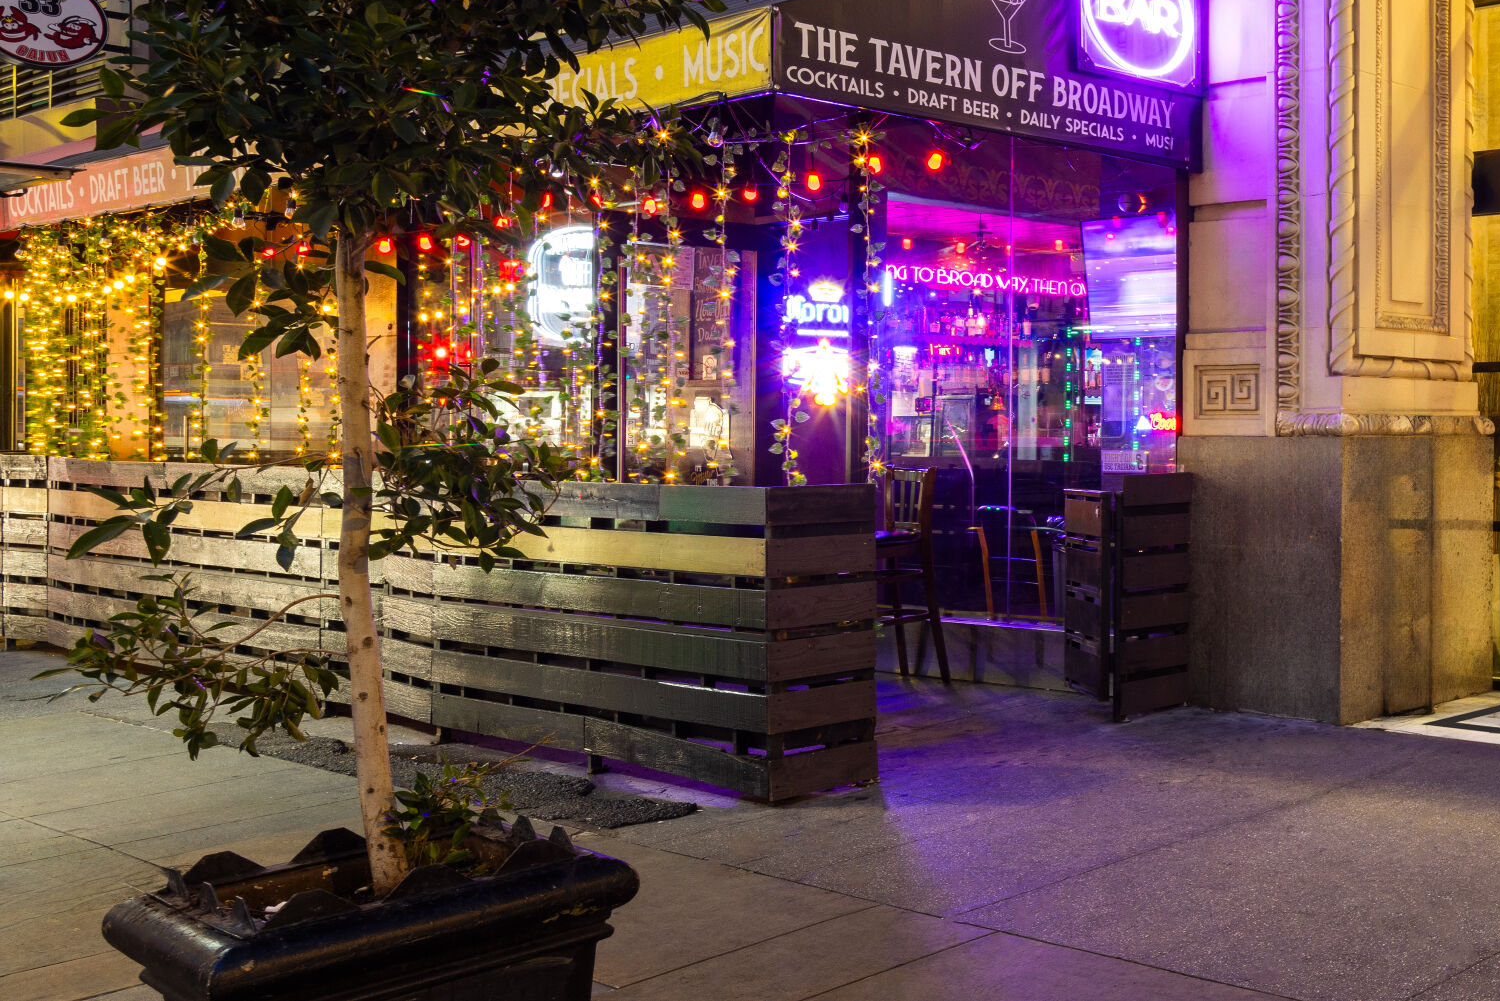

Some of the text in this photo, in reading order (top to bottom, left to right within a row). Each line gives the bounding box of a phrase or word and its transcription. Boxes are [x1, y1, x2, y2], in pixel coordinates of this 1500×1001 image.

[16, 45, 70, 61] CAJUN
[683, 27, 765, 87] MUSIC
[794, 21, 1175, 129] THE TAVERN OFF BROADWAY
[786, 65, 1174, 150] COCKTAILS DRAFT BEER DAILY SPECIALS MUSI
[9, 179, 74, 217] COCKTAILS
[89, 168, 129, 205] DRAFT
[133, 161, 166, 196] BEER
[910, 266, 934, 282] TO
[626, 420, 636, 446] PSH
